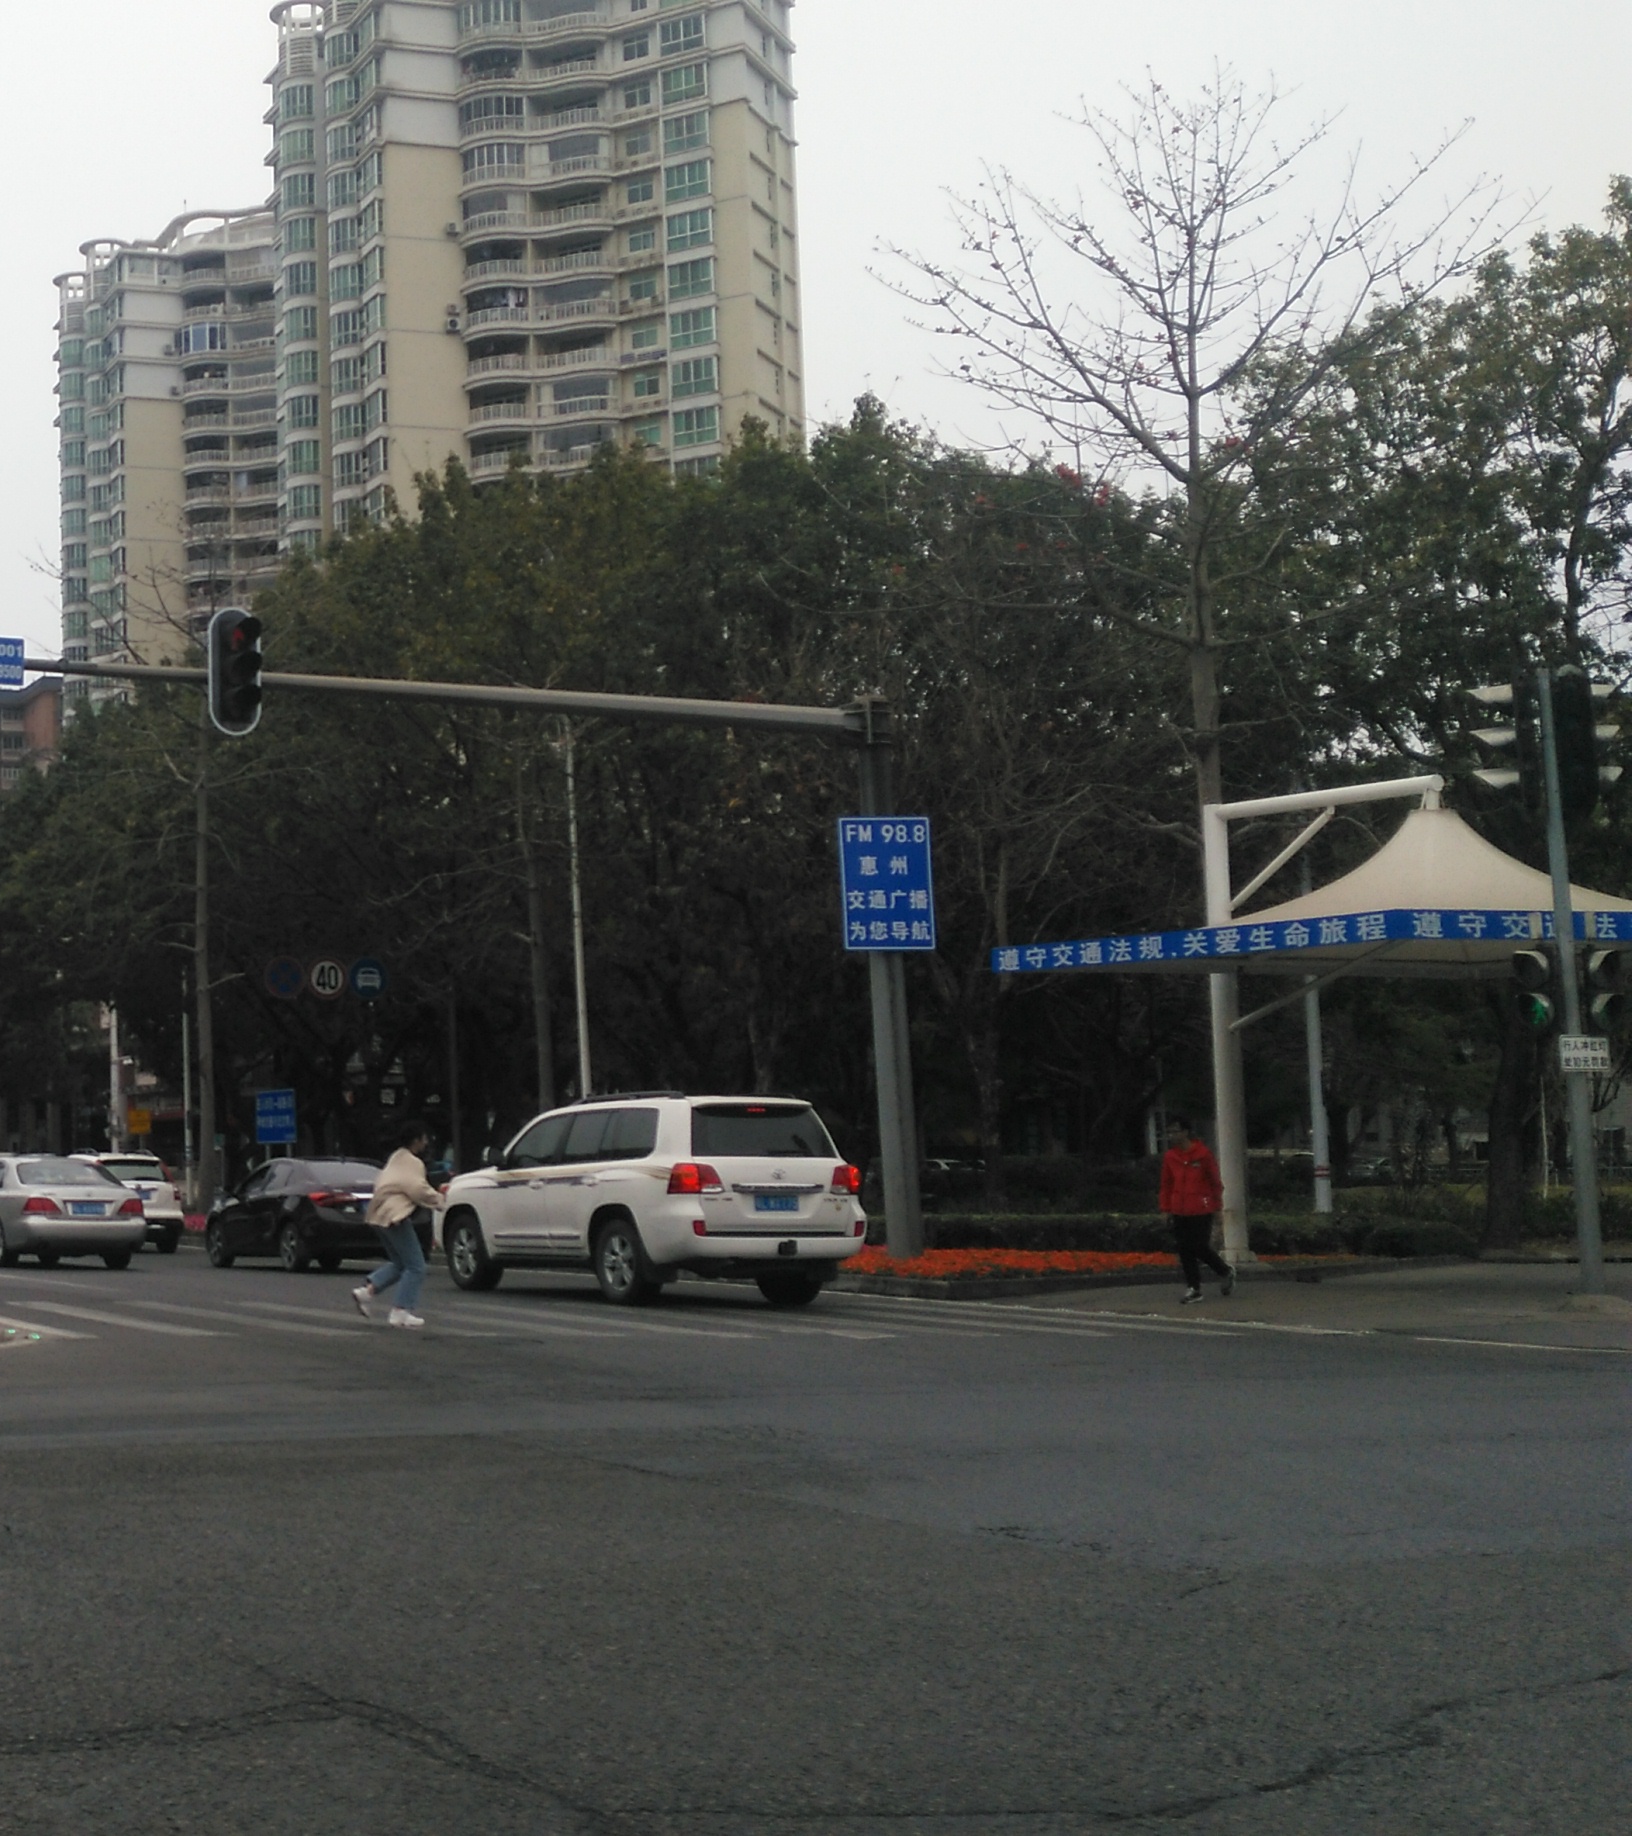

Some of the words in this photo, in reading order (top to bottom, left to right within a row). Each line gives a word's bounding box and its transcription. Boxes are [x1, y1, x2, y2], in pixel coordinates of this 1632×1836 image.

[845, 824, 873, 843] FM
[881, 824, 926, 843] 98.8
[859, 855, 909, 876] 惠州
[847, 889, 929, 910] 交通广播
[850, 920, 931, 941] 为您导航
[317, 964, 338, 990] 40
